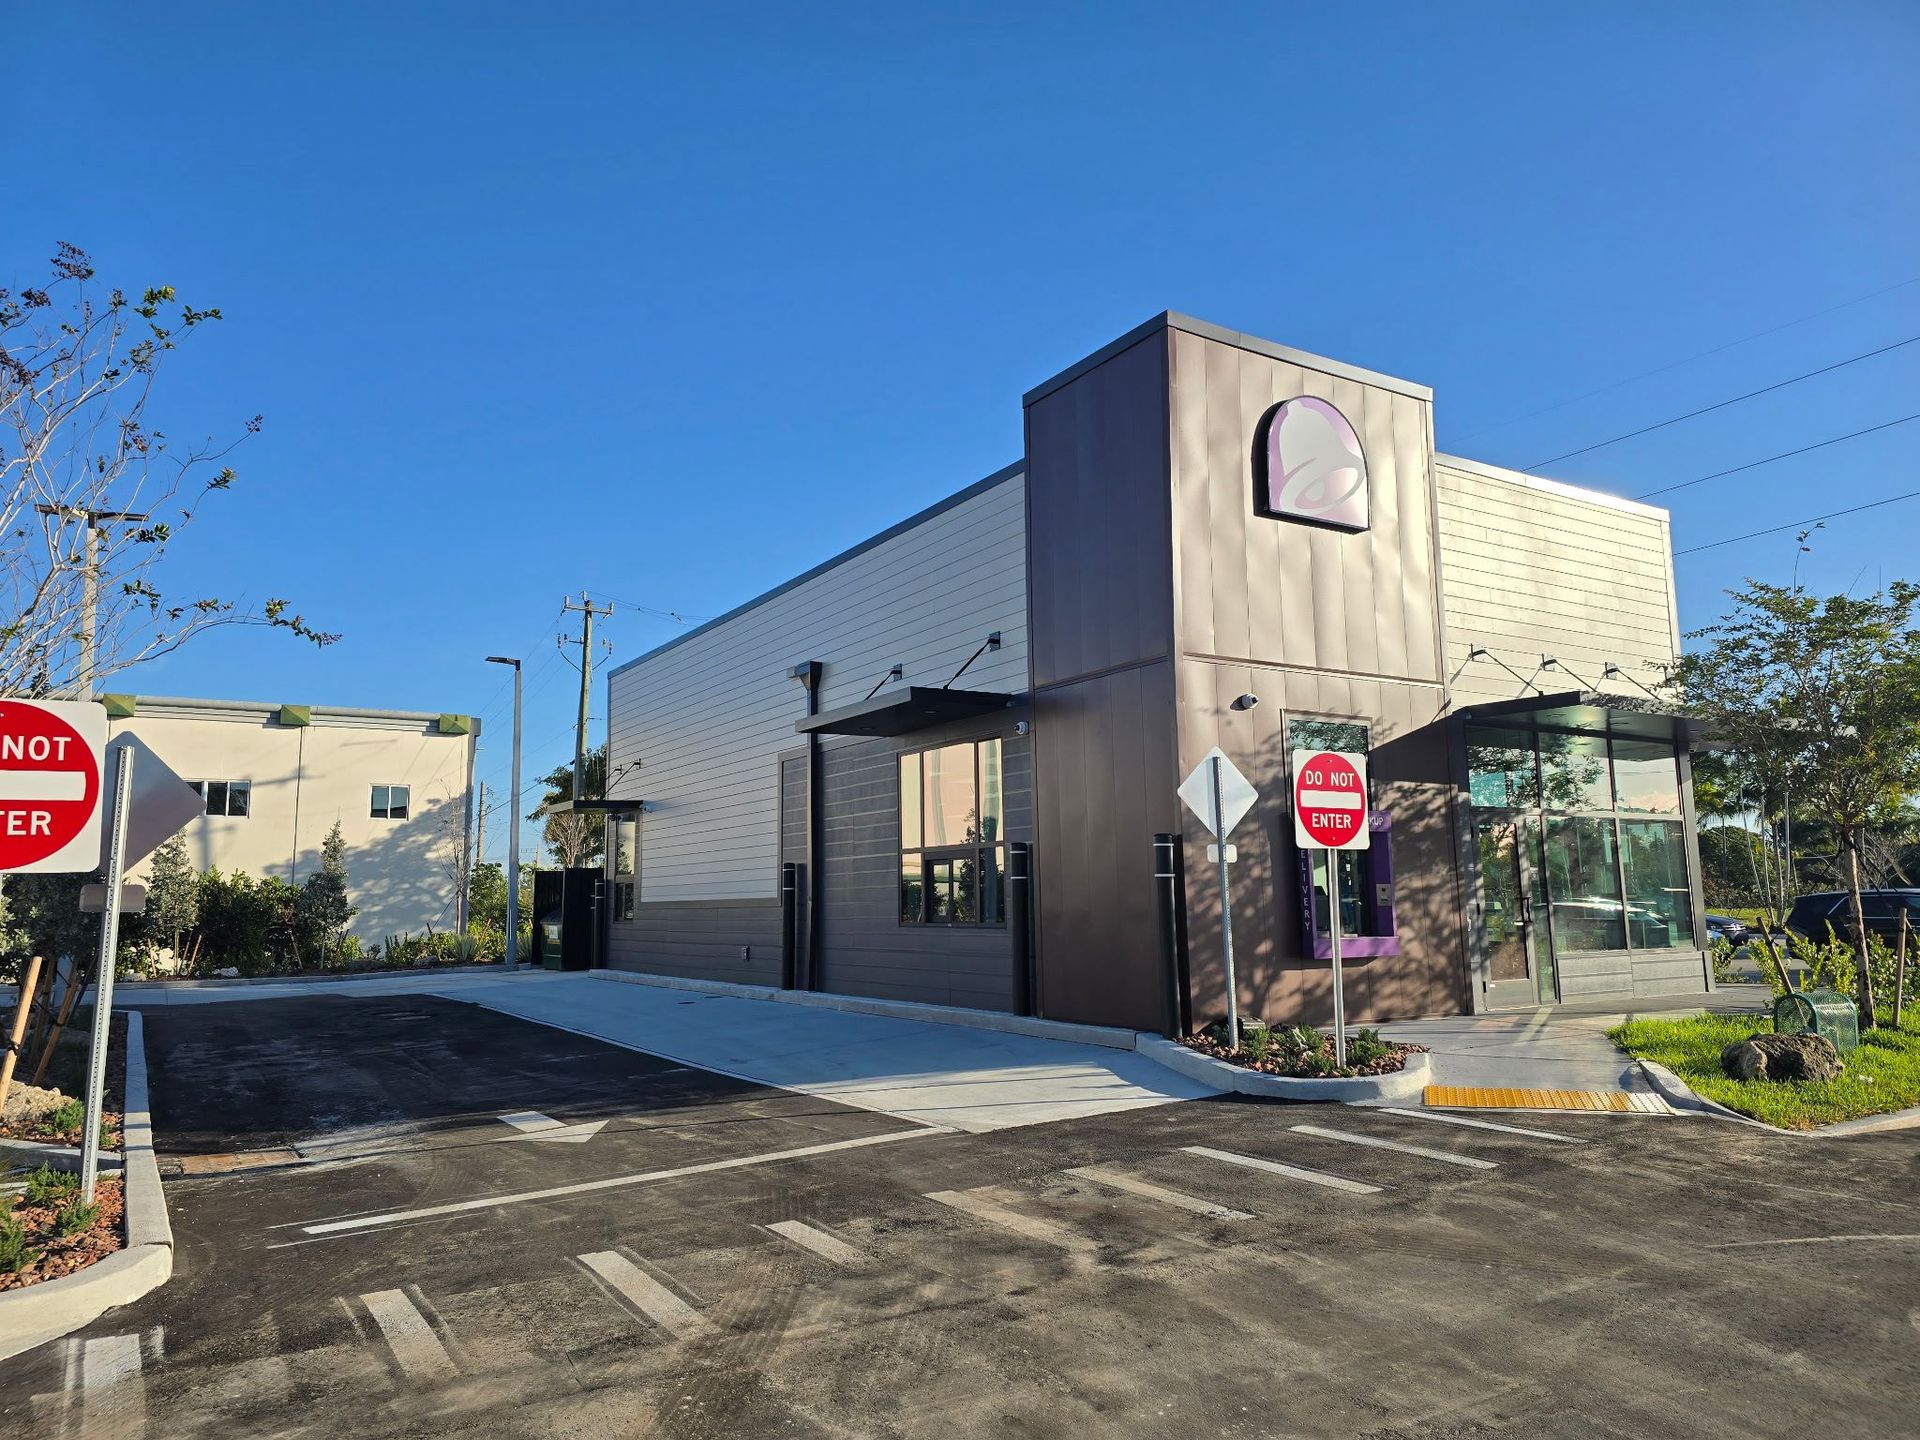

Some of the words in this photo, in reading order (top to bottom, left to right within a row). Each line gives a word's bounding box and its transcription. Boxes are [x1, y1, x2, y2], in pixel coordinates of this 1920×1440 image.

[2, 735, 72, 761] NOT
[1305, 770, 1323, 785] DO
[1330, 772, 1354, 787] NOT
[0, 810, 52, 836] ER
[1312, 813, 1352, 828] ENTER
[1369, 816, 1384, 826] KUP
[1300, 850, 1311, 931] ELIVERY
